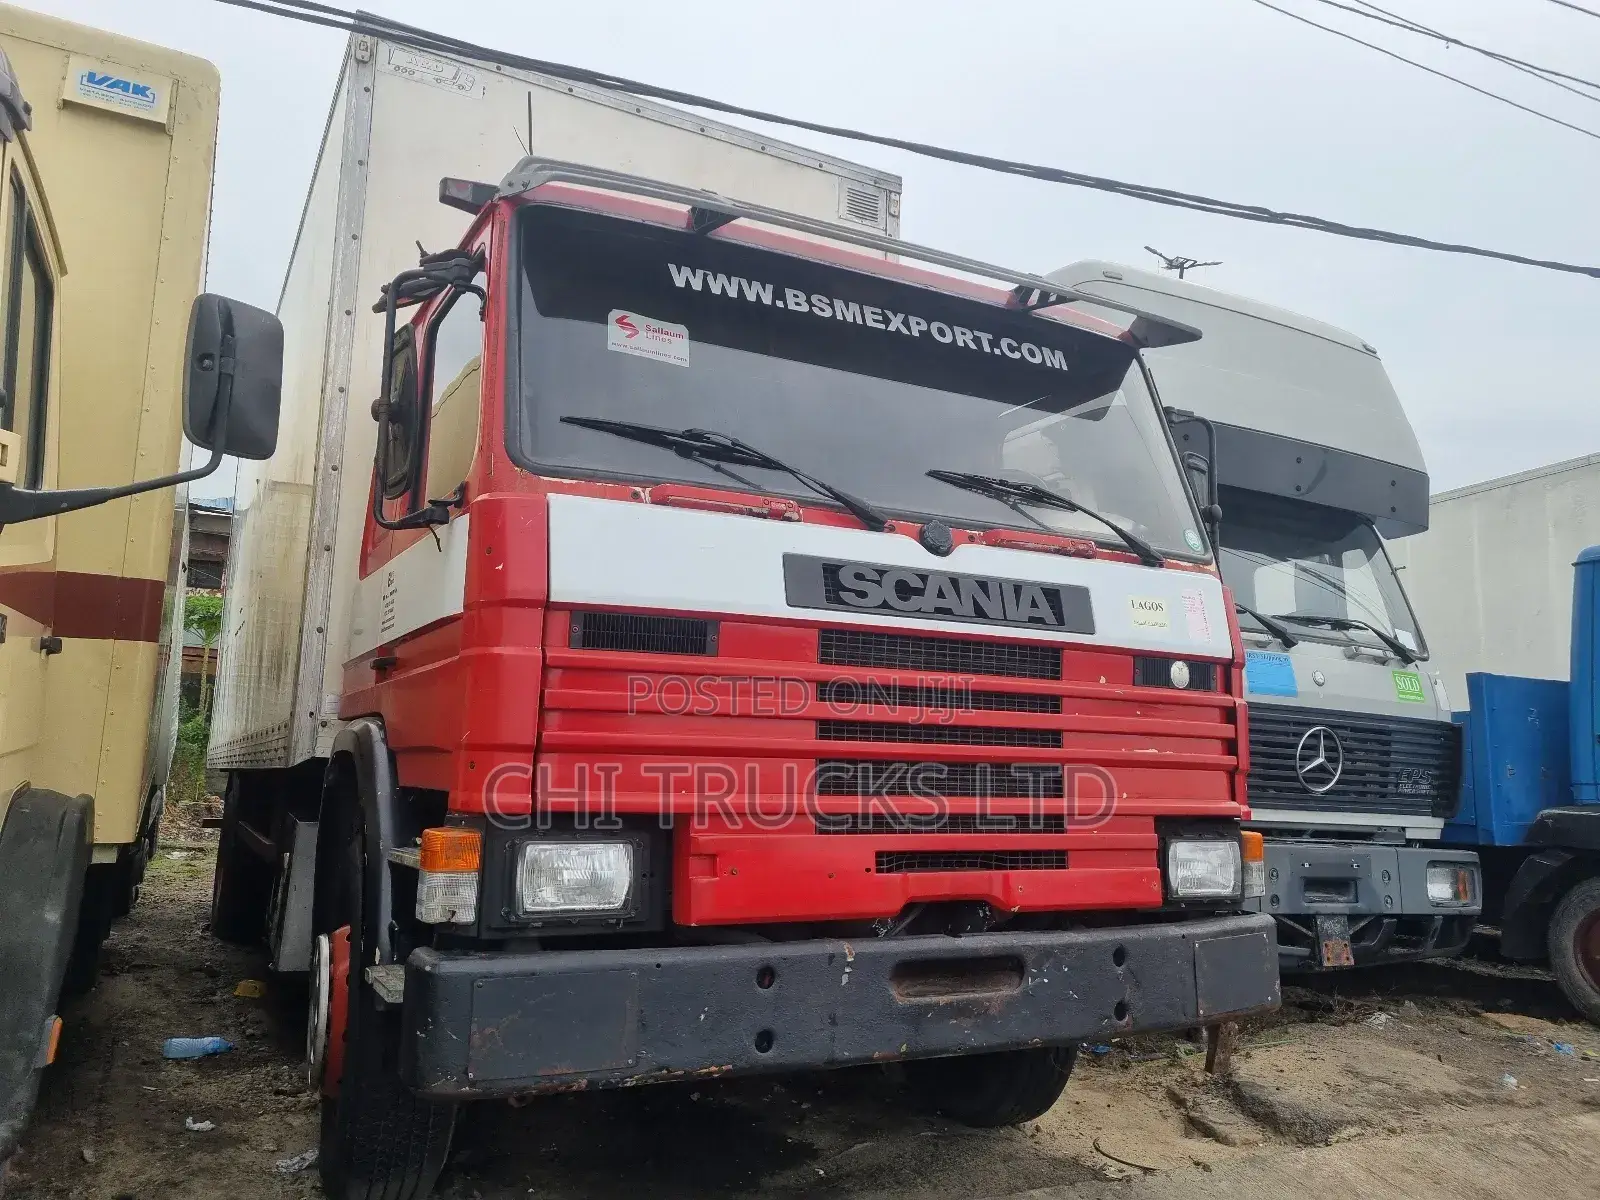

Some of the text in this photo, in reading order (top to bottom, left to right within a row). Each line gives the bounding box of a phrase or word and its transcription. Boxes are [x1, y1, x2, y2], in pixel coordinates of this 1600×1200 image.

[86, 70, 152, 98] VAK
[667, 262, 1069, 372] WWW.BSMEXPORT.COM
[645, 324, 684, 340] Sallaum
[645, 332, 672, 345] Lines
[838, 564, 1058, 625] SCANIA
[1131, 599, 1164, 612] LAGOS
[1396, 676, 1420, 691] SOLD
[1398, 767, 1432, 785] EPS
